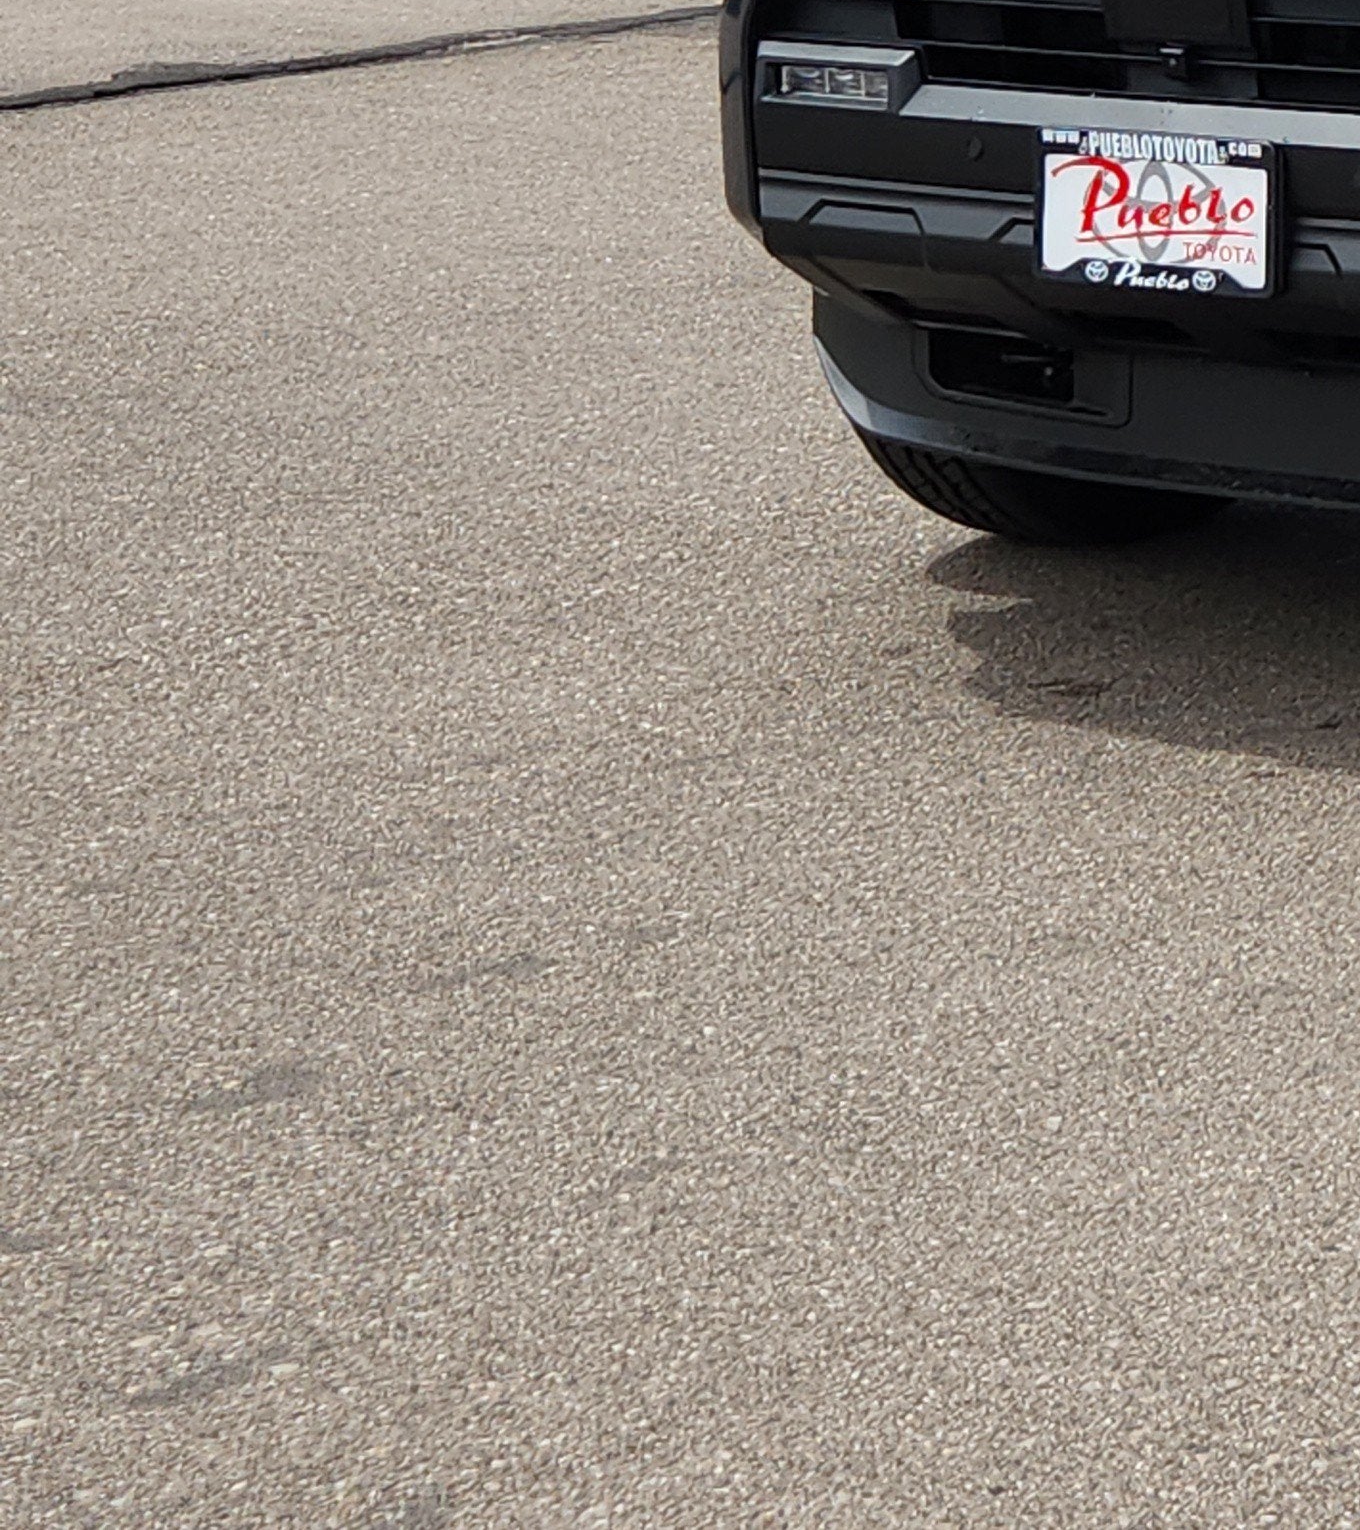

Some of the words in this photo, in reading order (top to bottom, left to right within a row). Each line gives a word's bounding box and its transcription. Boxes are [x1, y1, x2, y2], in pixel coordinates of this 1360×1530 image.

[1051, 156, 1255, 234] Pueblo
[1183, 241, 1257, 266] TOYOTA
[1112, 259, 1190, 291] Pueblo
